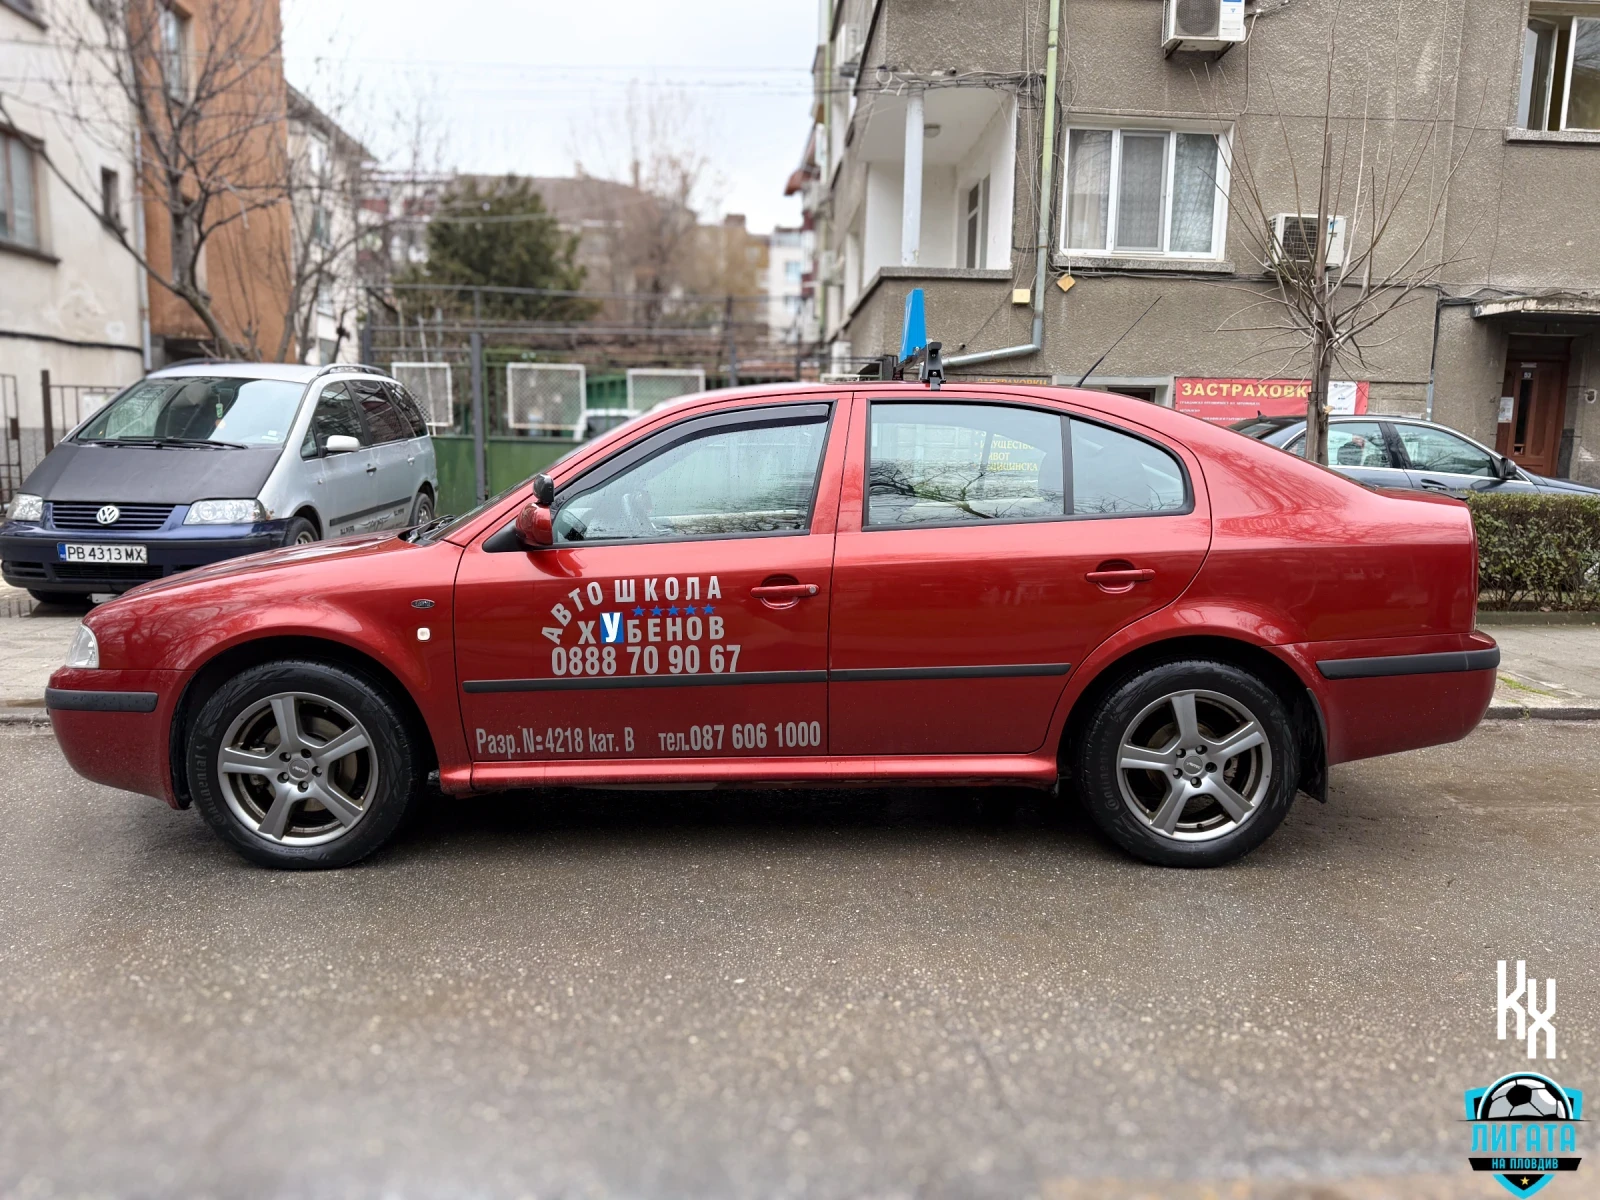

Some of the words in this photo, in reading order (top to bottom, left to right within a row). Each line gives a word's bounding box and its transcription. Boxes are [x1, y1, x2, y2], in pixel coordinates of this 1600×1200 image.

[67, 546, 86, 560] PB
[88, 547, 122, 561] 4313
[124, 548, 145, 562] MX
[577, 612, 725, 645] ХУБЕНОВ
[551, 646, 617, 676] 0888
[627, 645, 659, 674] 70
[668, 645, 700, 674] 90
[709, 644, 741, 673] 67
[732, 723, 767, 749] 606
[774, 721, 821, 747] 1000
